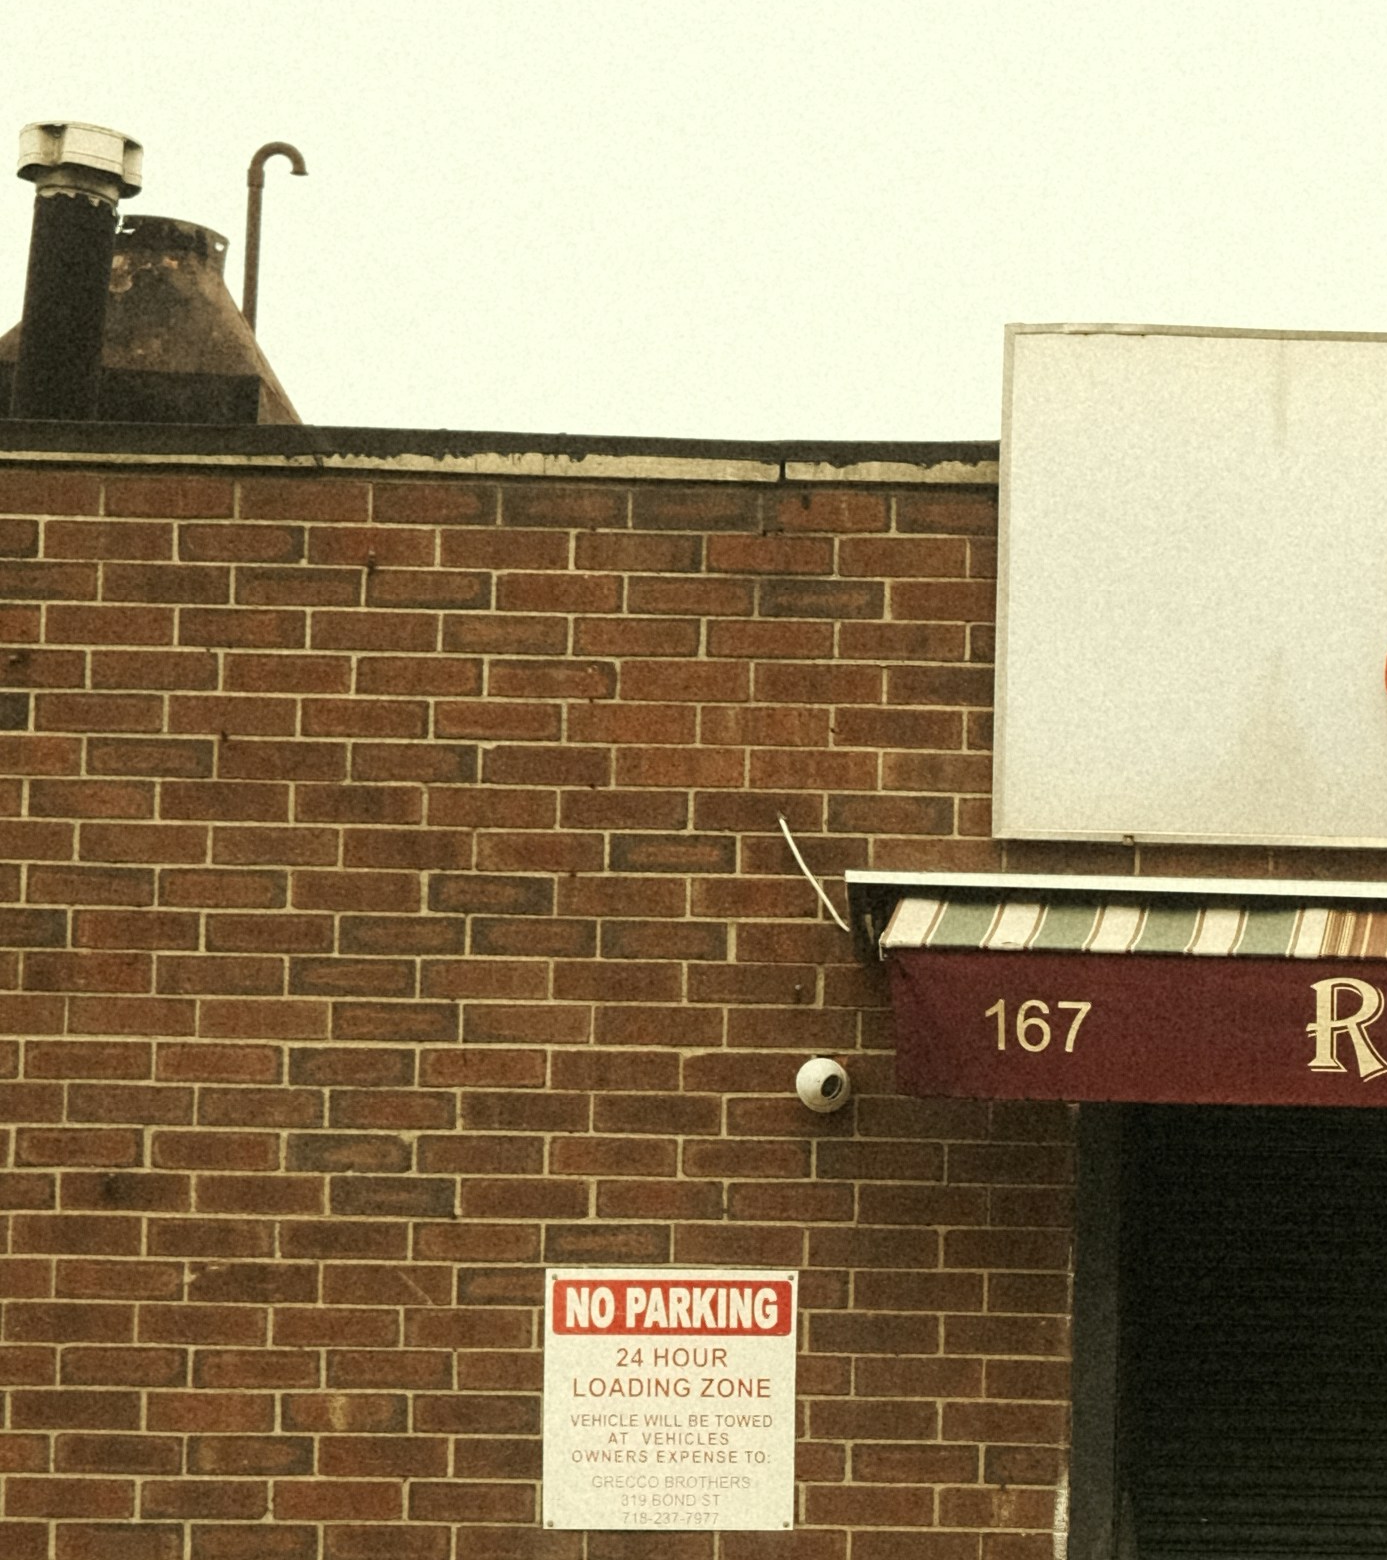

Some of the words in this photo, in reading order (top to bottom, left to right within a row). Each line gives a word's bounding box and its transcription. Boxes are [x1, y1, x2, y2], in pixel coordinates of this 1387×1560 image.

[982, 997, 1093, 1055] 167
[565, 1287, 615, 1328] NO
[626, 1287, 778, 1329] PARKING
[616, 1348, 644, 1368] 24
[654, 1348, 728, 1368] HOUR
[573, 1378, 691, 1398] LOADING
[700, 1378, 772, 1398] ZONE
[571, 1414, 639, 1428] VEHICLE
[644, 1414, 682, 1428] WILL
[688, 1414, 709, 1428] BE
[716, 1414, 773, 1428] TOWED
[608, 1432, 628, 1446] AT
[642, 1432, 730, 1446] VEHICLES
[572, 1450, 648, 1463] OWNERS
[656, 1450, 738, 1464] EXPENSE
[745, 1450, 772, 1464] TO:
[592, 1475, 660, 1489] GRECCO
[664, 1475, 752, 1489] BROTHERS
[652, 1494, 697, 1507] BOND
[701, 1494, 722, 1507] ST
